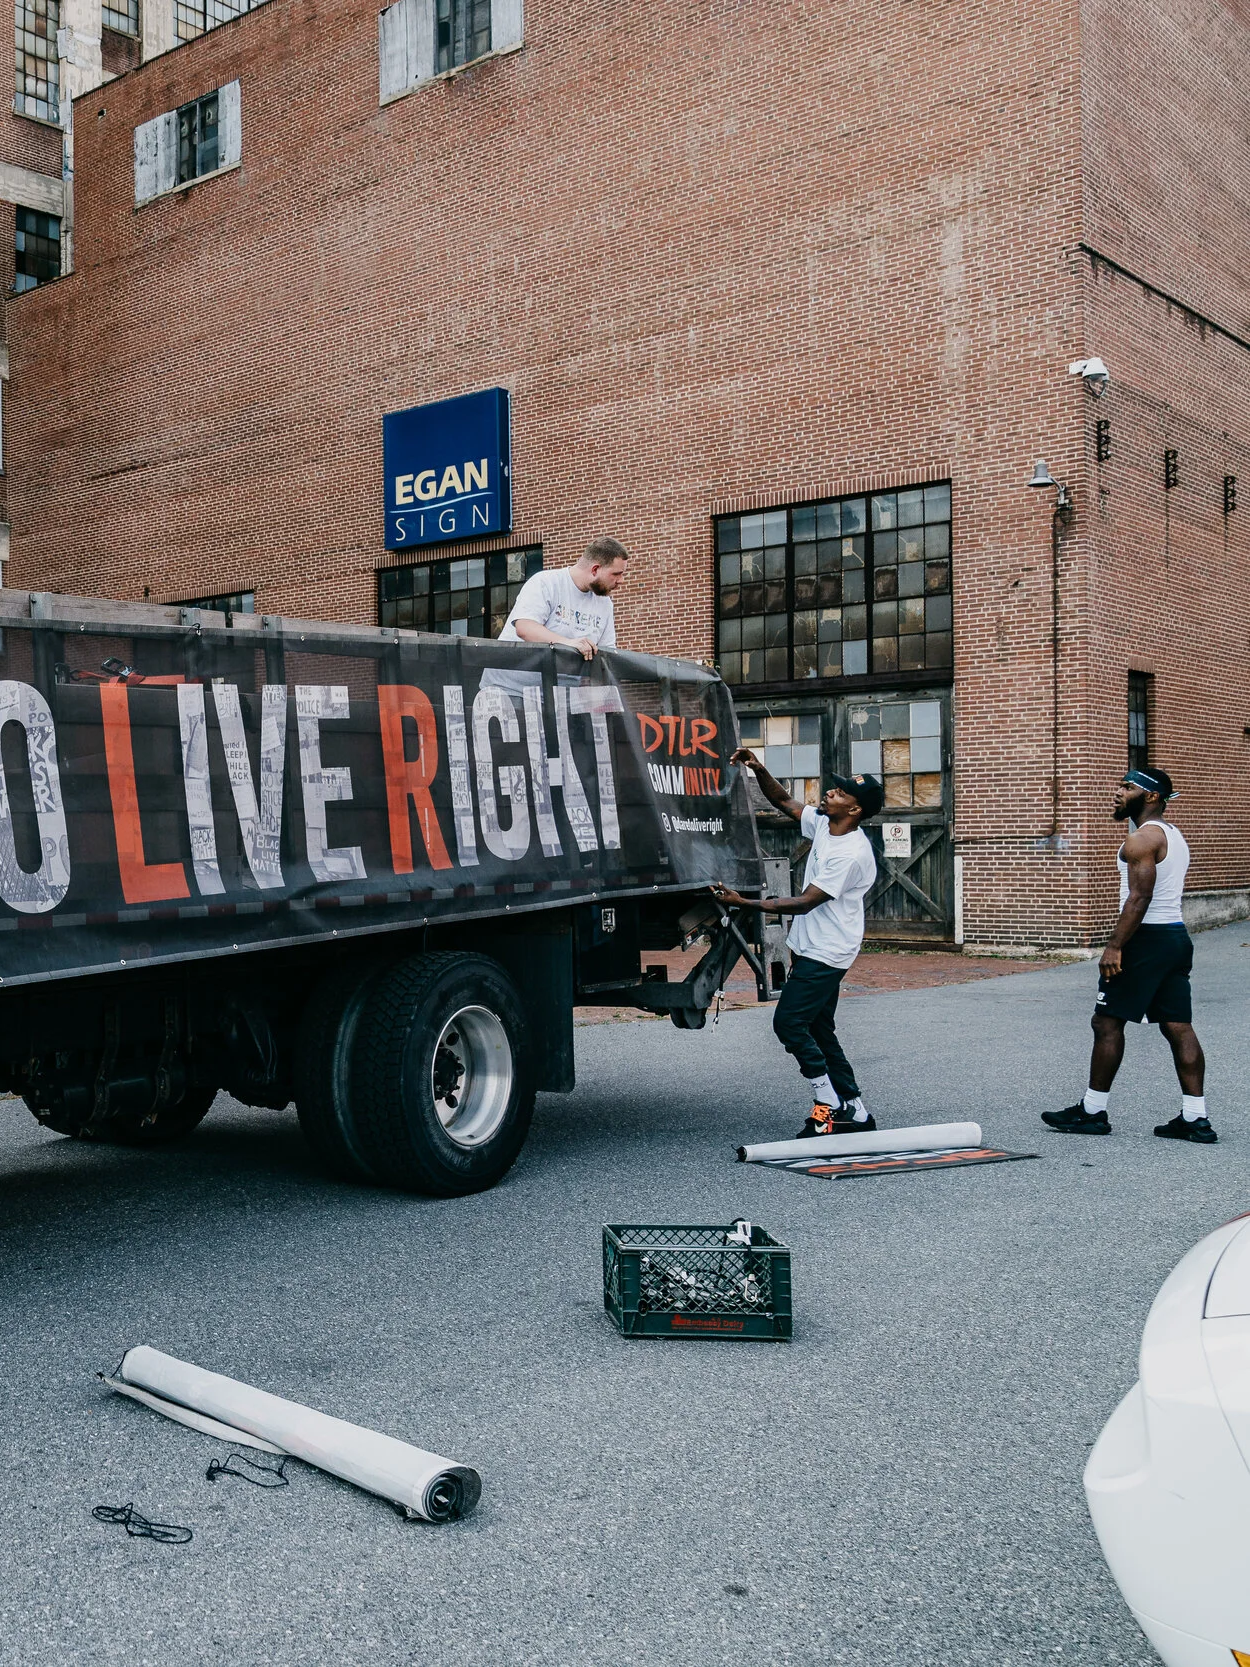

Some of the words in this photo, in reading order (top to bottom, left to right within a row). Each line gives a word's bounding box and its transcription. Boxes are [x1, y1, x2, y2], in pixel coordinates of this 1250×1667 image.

[395, 458, 488, 506] EGAN
[395, 502, 489, 541] SIGN
[636, 712, 720, 759] DTLR
[100, 682, 368, 904] LIVE
[377, 683, 625, 874] RIGHT
[647, 762, 721, 796] COMMUNITY
